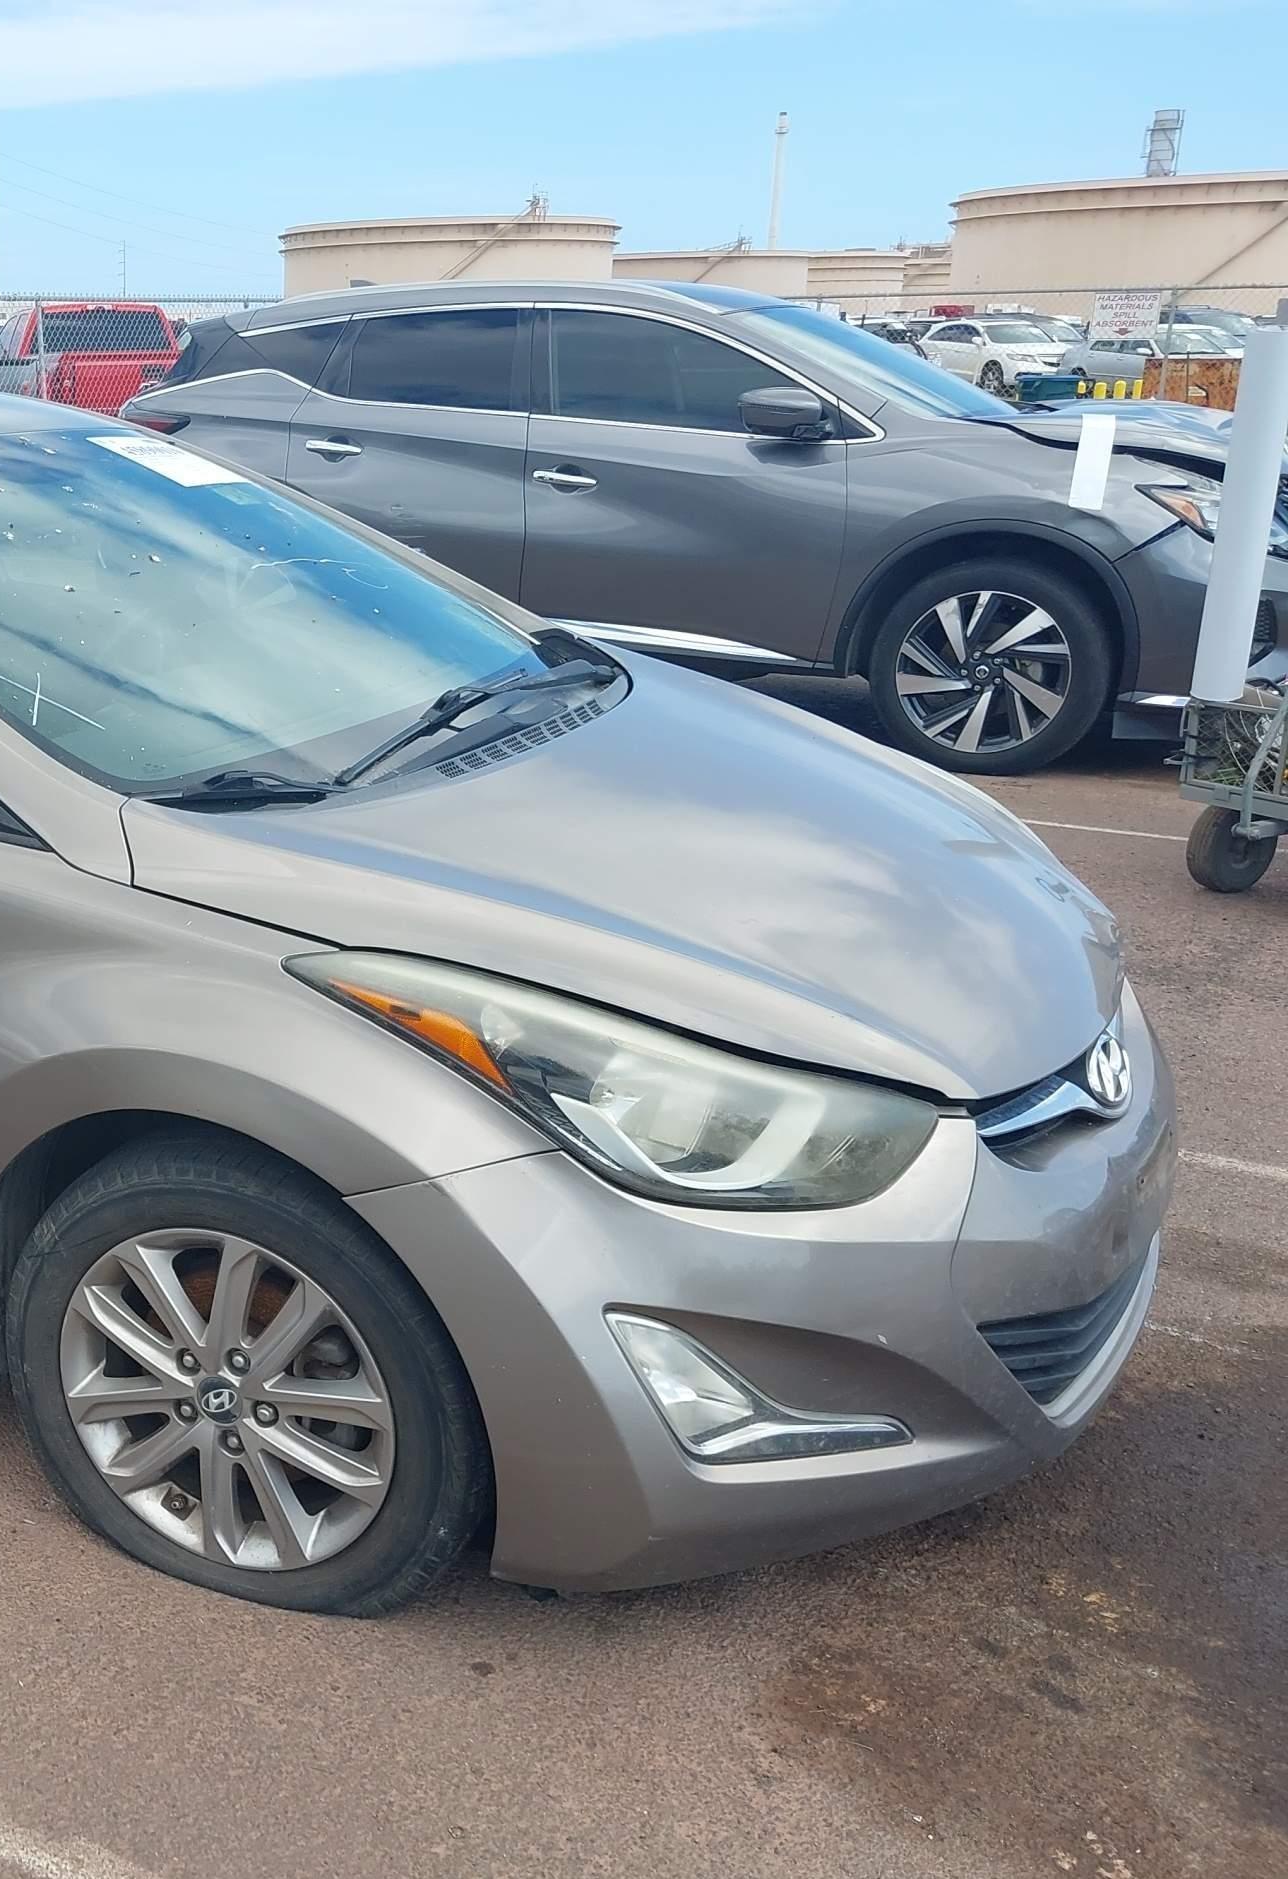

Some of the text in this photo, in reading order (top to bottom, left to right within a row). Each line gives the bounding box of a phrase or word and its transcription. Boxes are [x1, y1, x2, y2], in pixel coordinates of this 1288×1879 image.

[1096, 294, 1159, 302] HAZARDOUS
[1099, 302, 1154, 310] MATERIALS
[1112, 311, 1139, 319] SPILL
[1094, 320, 1155, 328] ABSORBENT
